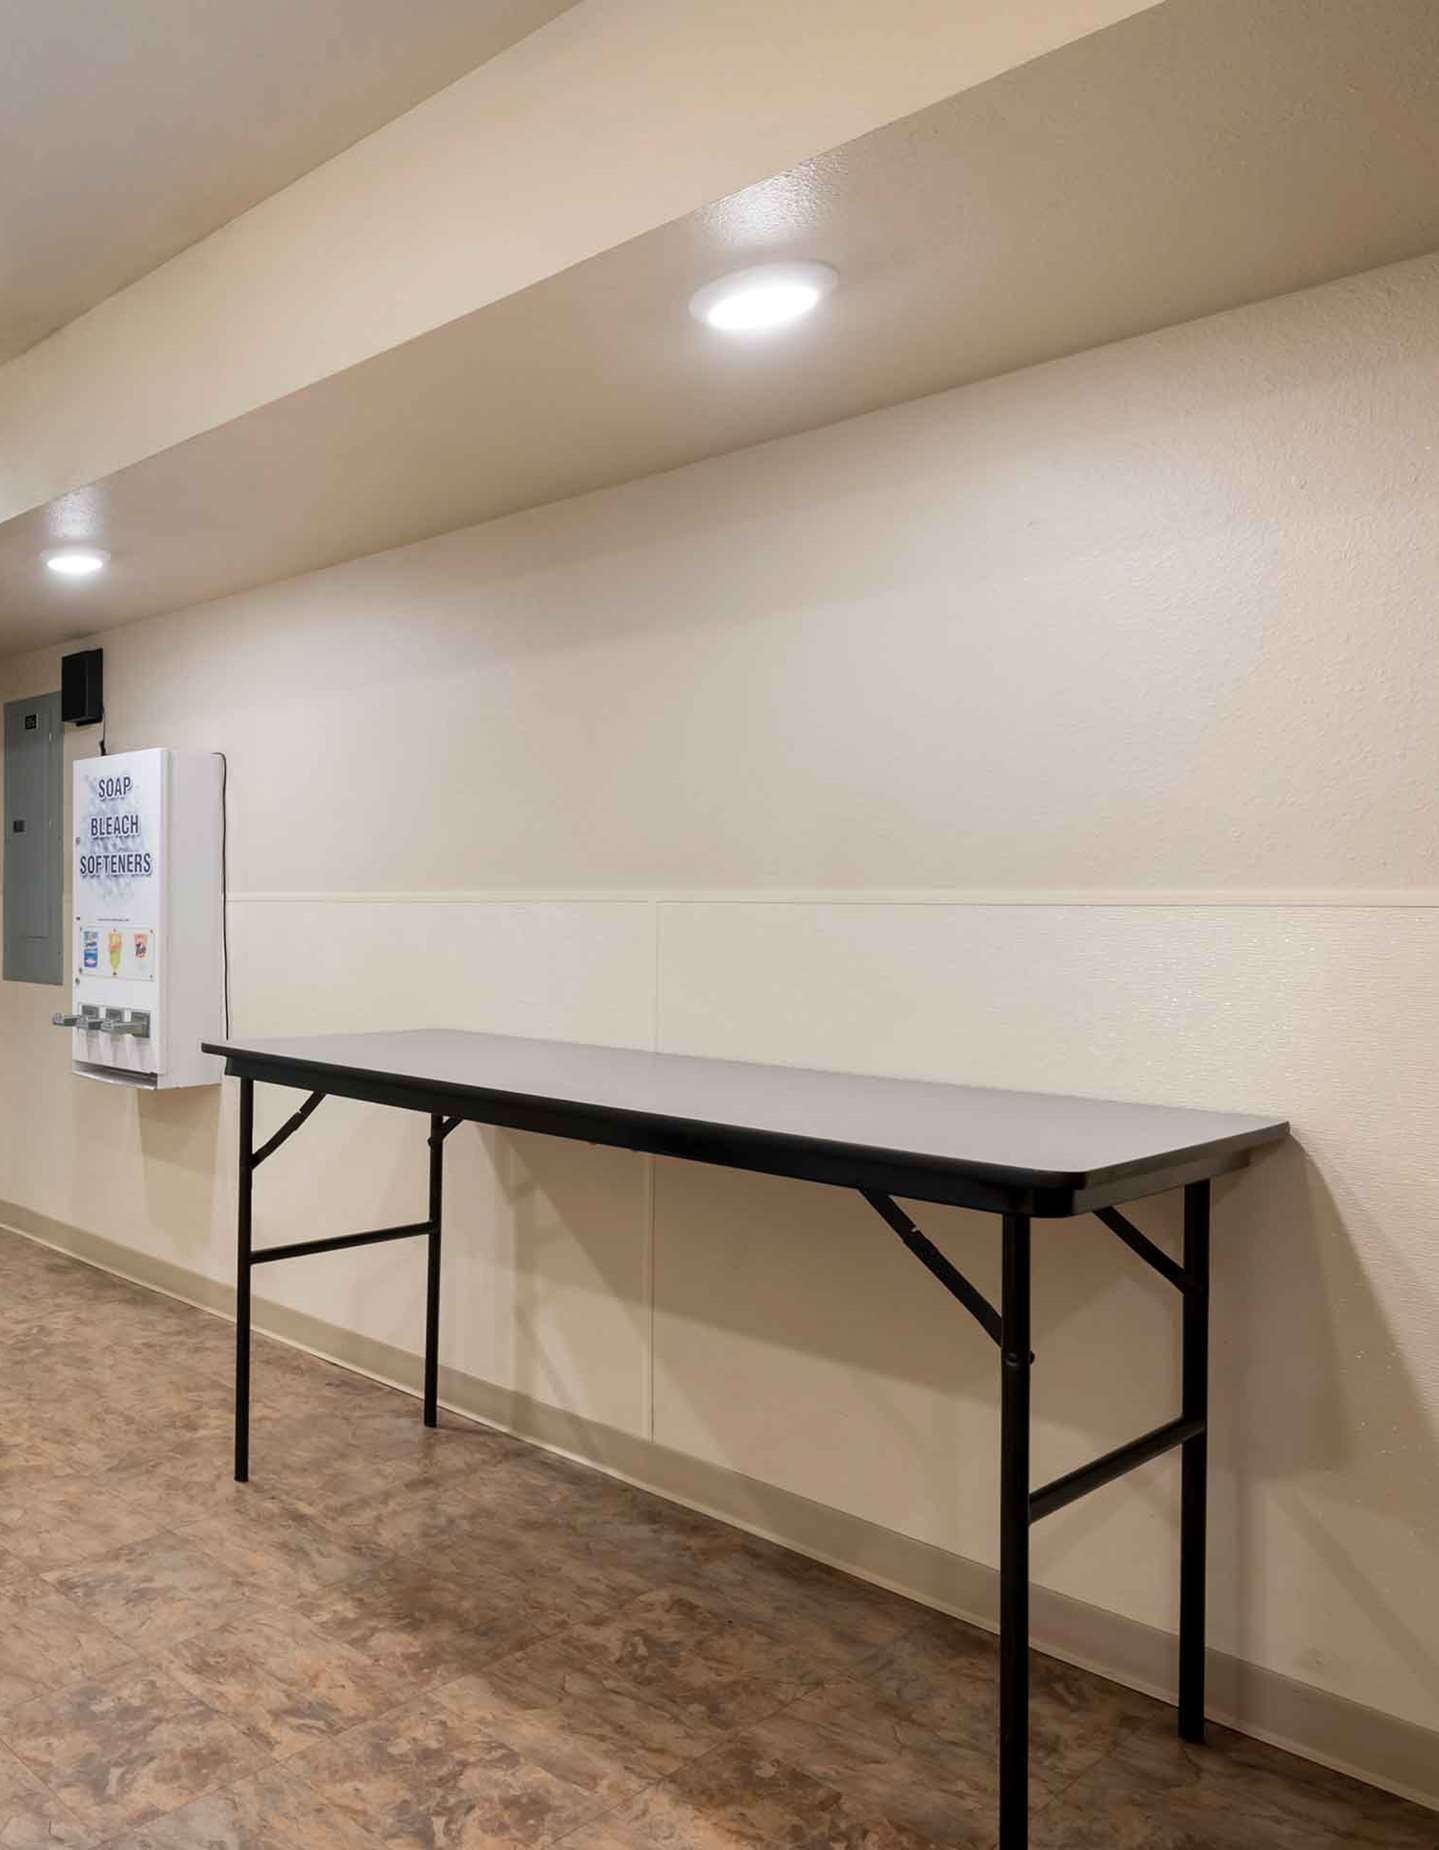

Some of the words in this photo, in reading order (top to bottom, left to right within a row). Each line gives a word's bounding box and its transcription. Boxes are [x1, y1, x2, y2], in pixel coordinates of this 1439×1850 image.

[98, 776, 132, 799] SOAP
[91, 815, 139, 837] BLEACH
[80, 853, 152, 875] SOFTENERS
